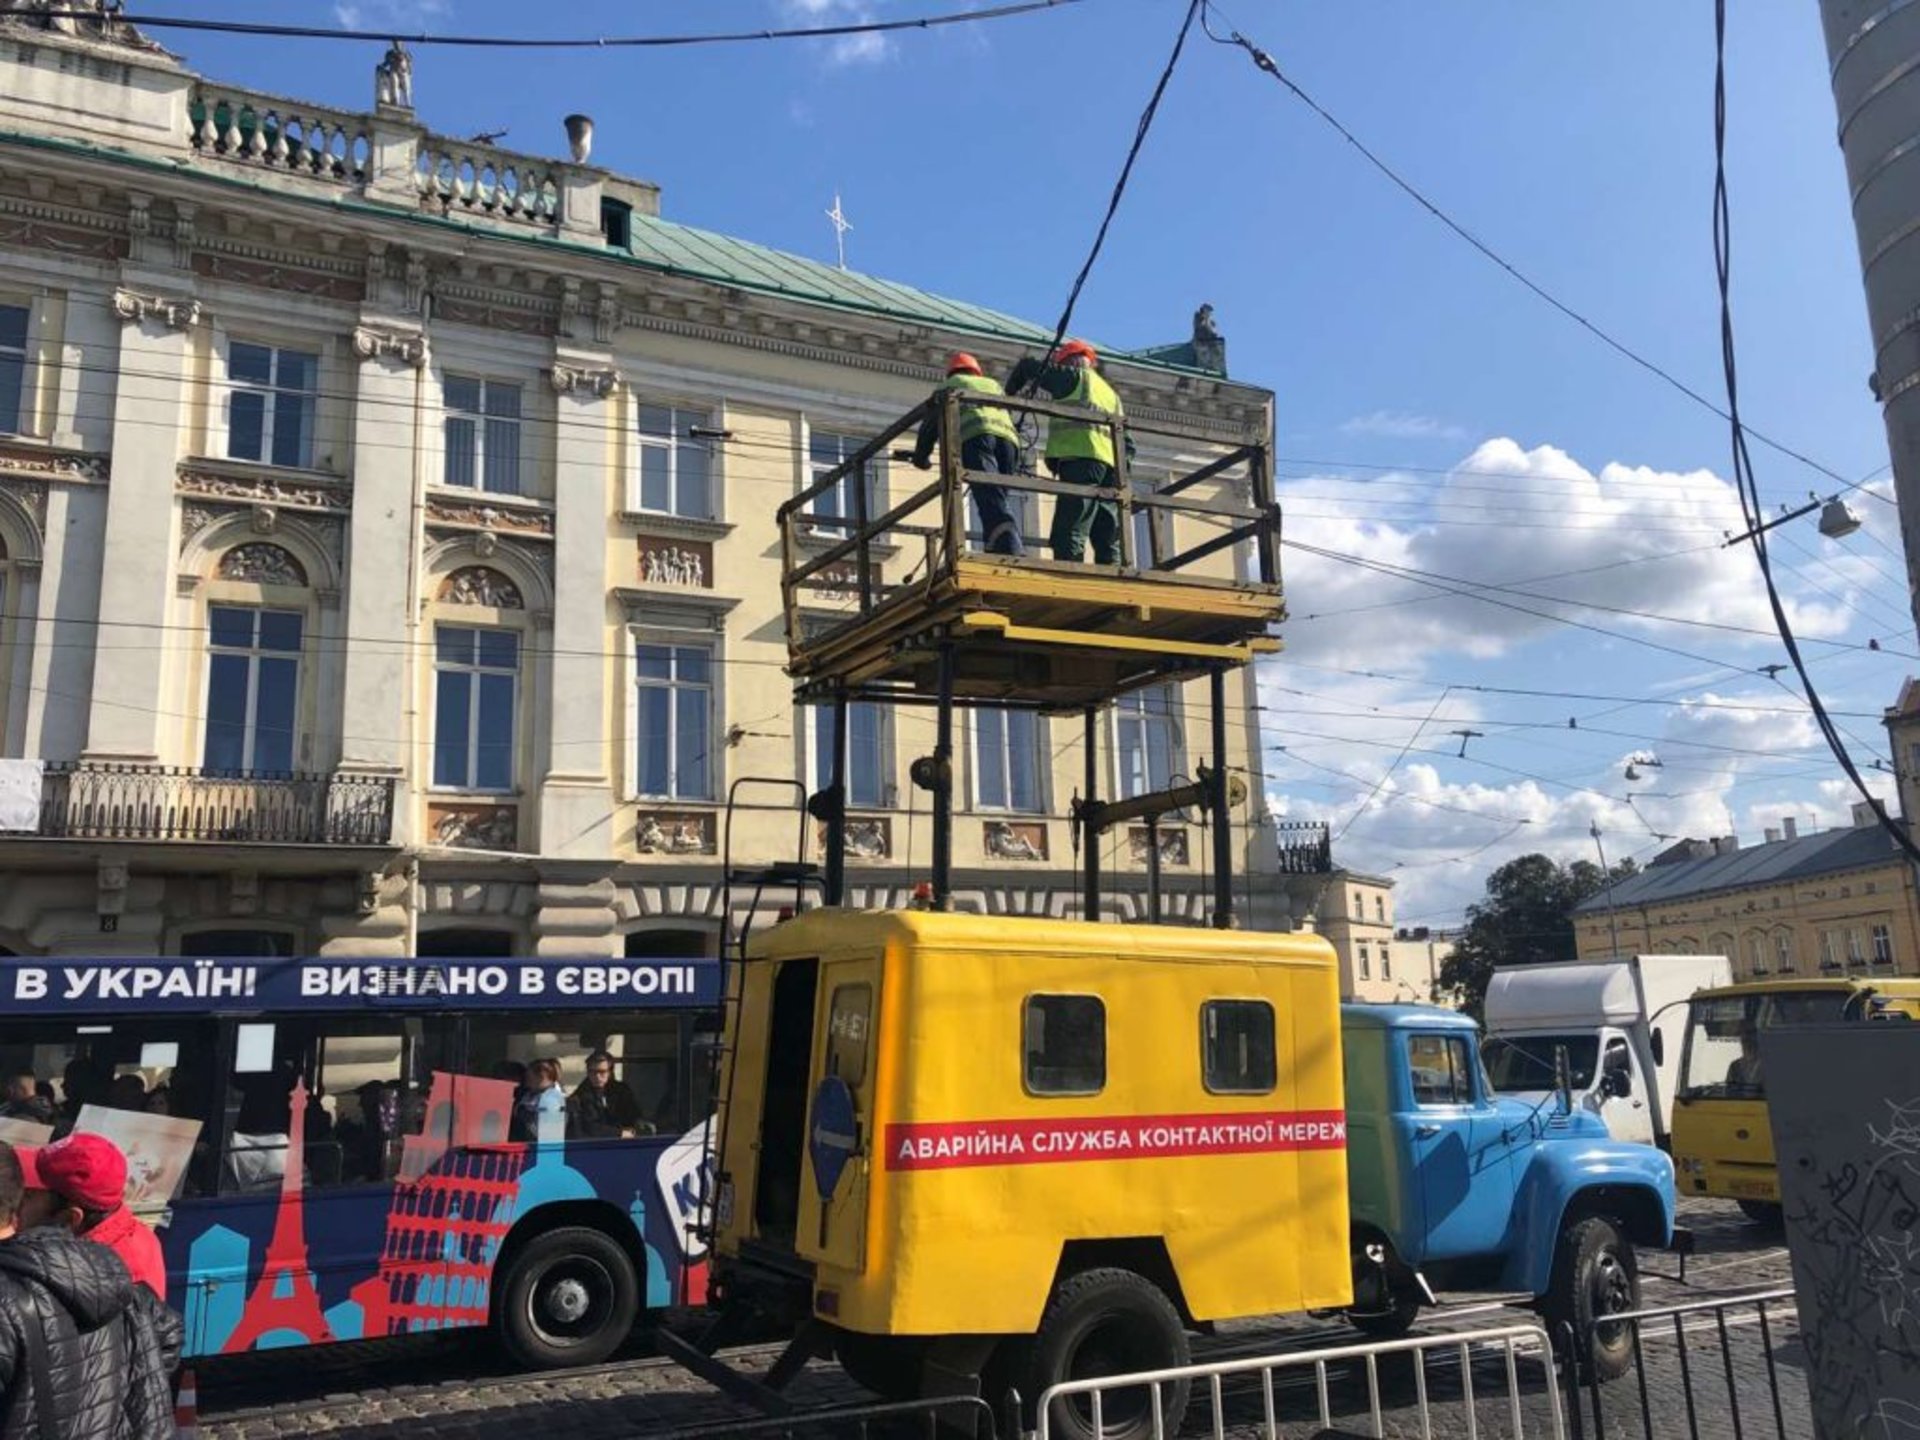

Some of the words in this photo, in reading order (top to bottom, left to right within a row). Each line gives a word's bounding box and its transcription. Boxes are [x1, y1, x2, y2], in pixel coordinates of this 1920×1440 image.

[15, 968, 48, 999] В
[63, 960, 257, 999] УКРАЇНІ
[302, 966, 508, 995] ВИЗНАНО
[520, 966, 545, 994] В
[556, 966, 695, 994] ЄВРОПІ
[900, 1130, 1025, 1160] АВАРІЙНА
[1031, 1129, 1132, 1153] СЛУЖБА
[1139, 1119, 1273, 1149] КОНТАКТНОЇ
